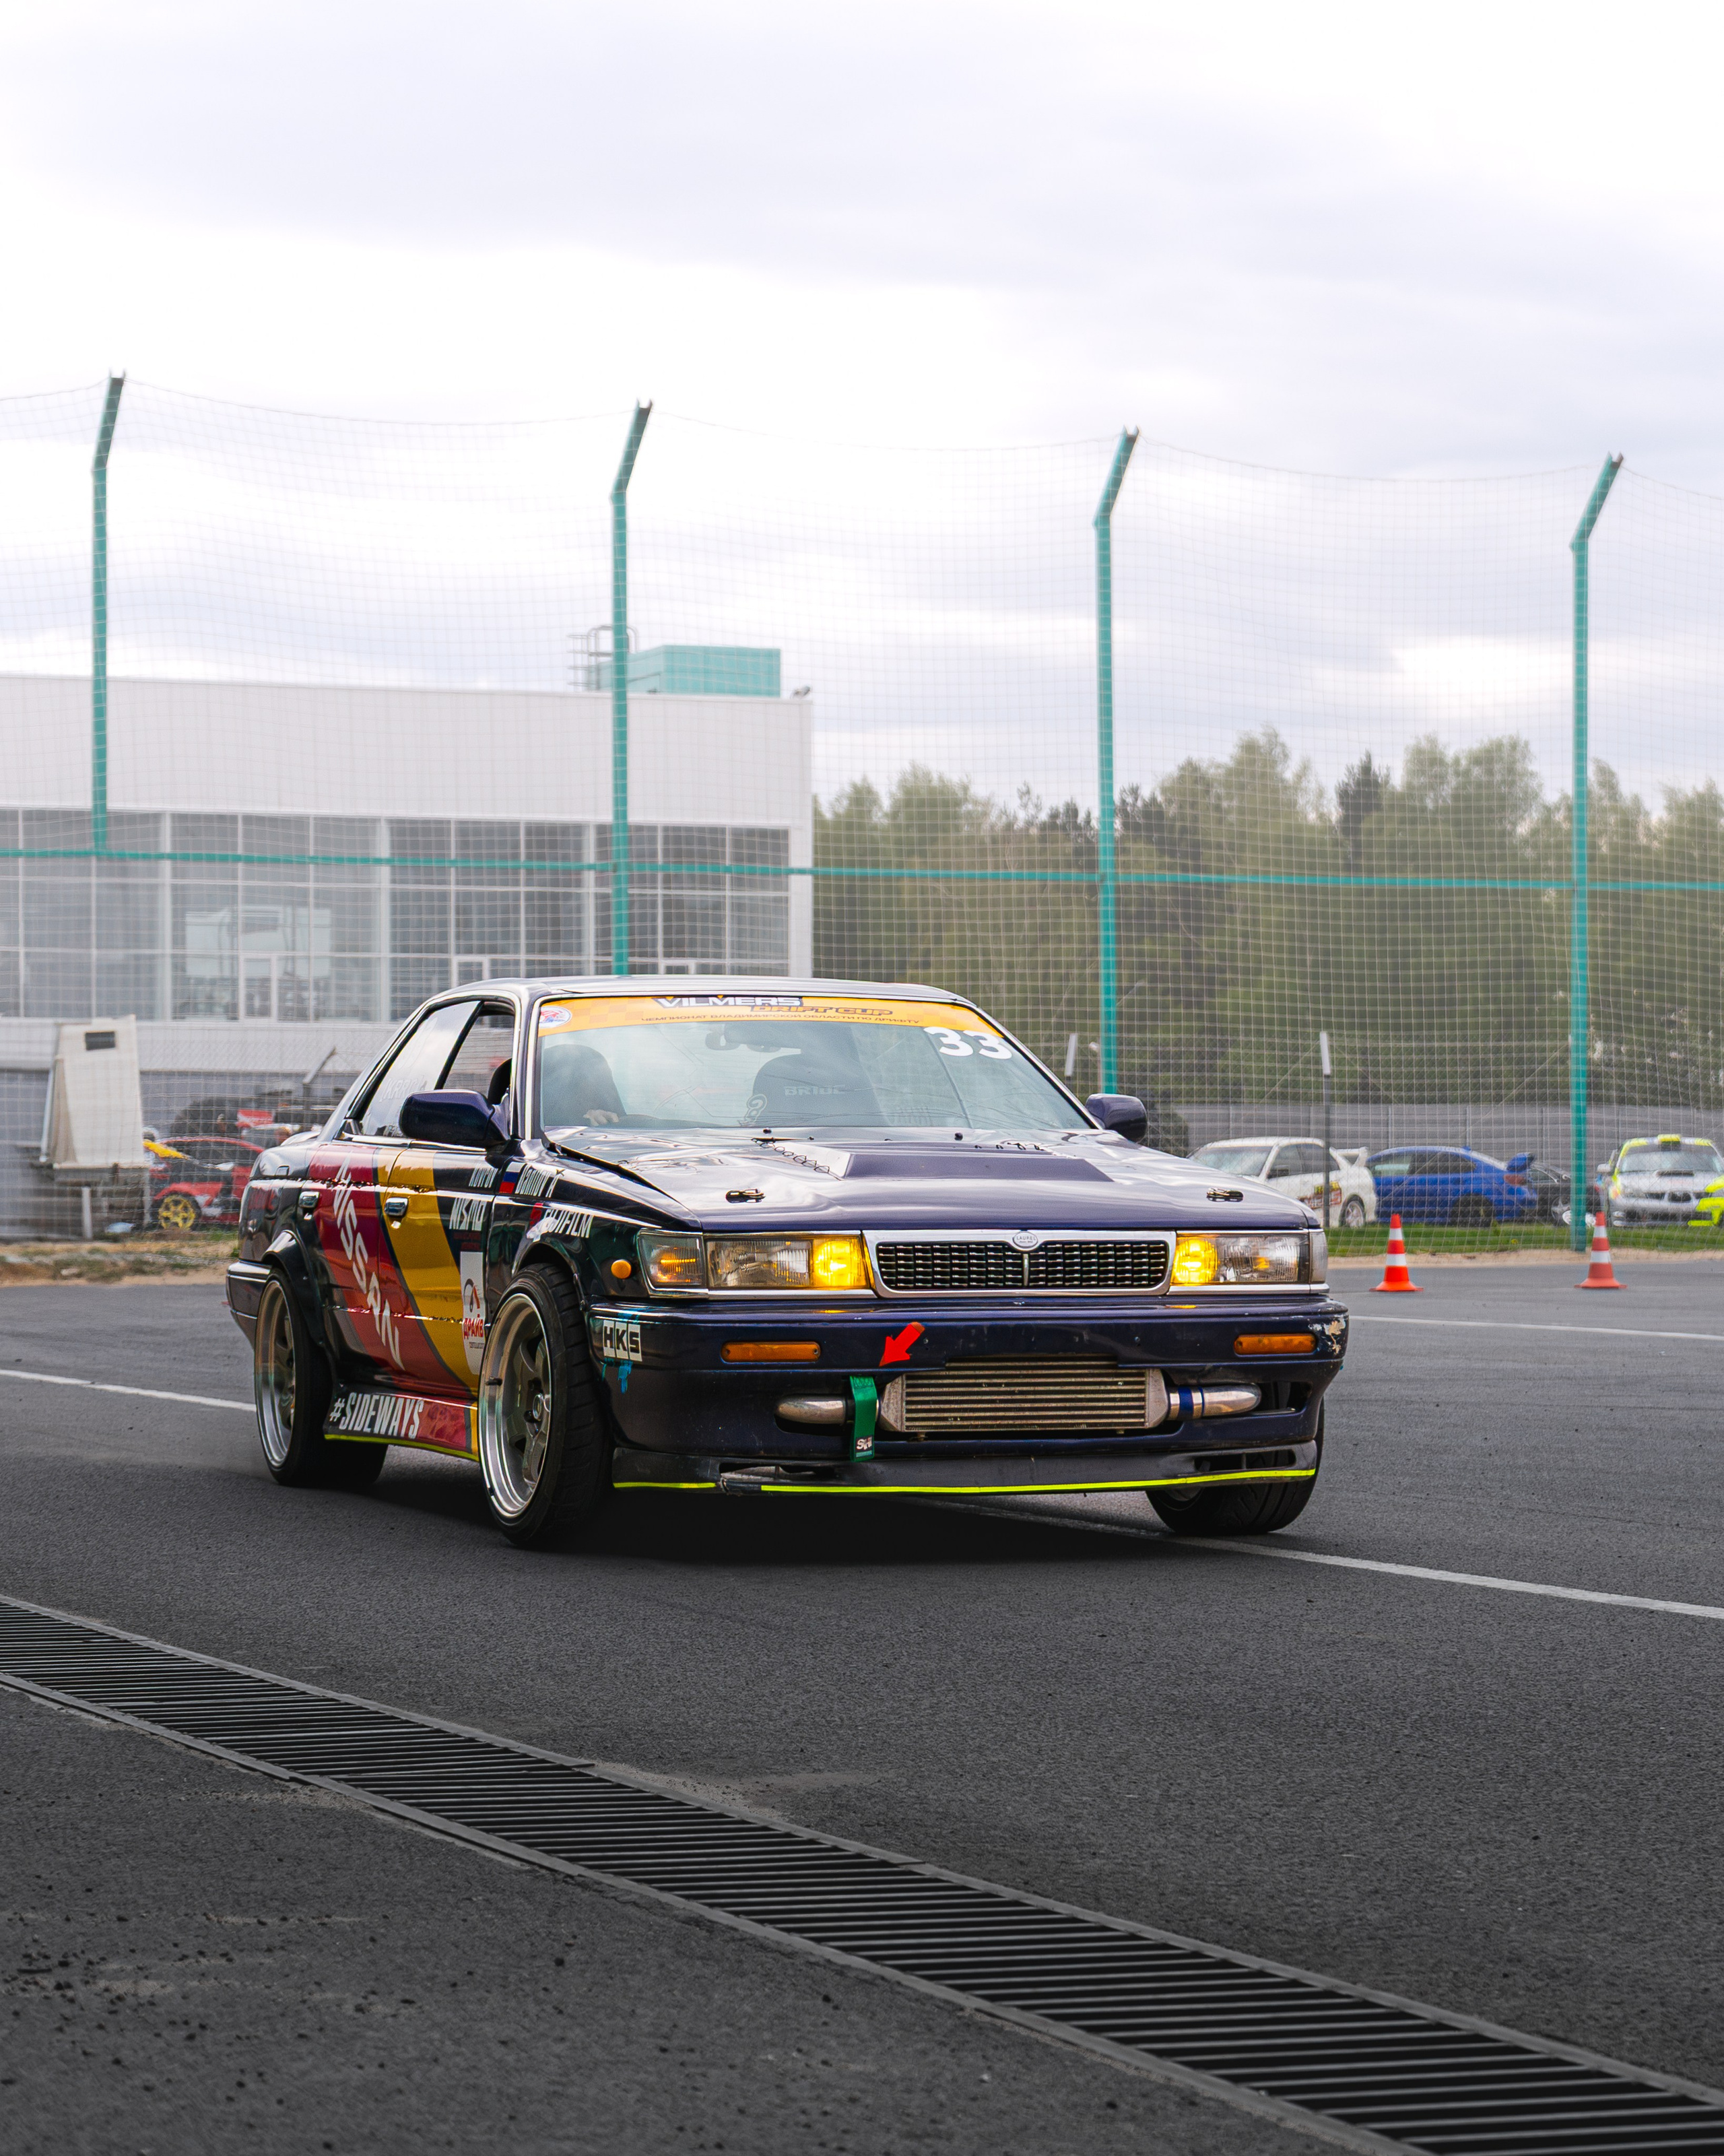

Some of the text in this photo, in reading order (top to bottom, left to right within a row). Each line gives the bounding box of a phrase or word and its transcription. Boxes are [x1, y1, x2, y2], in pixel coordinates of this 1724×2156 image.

[652, 997, 803, 1008] VILMERS
[750, 1005, 893, 1016] DRIFT CUP
[923, 1026, 1012, 1059] 33
[449, 1197, 488, 1232] NISMO
[538, 1208, 595, 1239] FUJIFILM
[333, 1150, 405, 1371] NISSAN
[463, 1314, 484, 1340] ДРАЙВ
[603, 1325, 640, 1354] HKS
[329, 1392, 425, 1440] #SIDEWAYS
